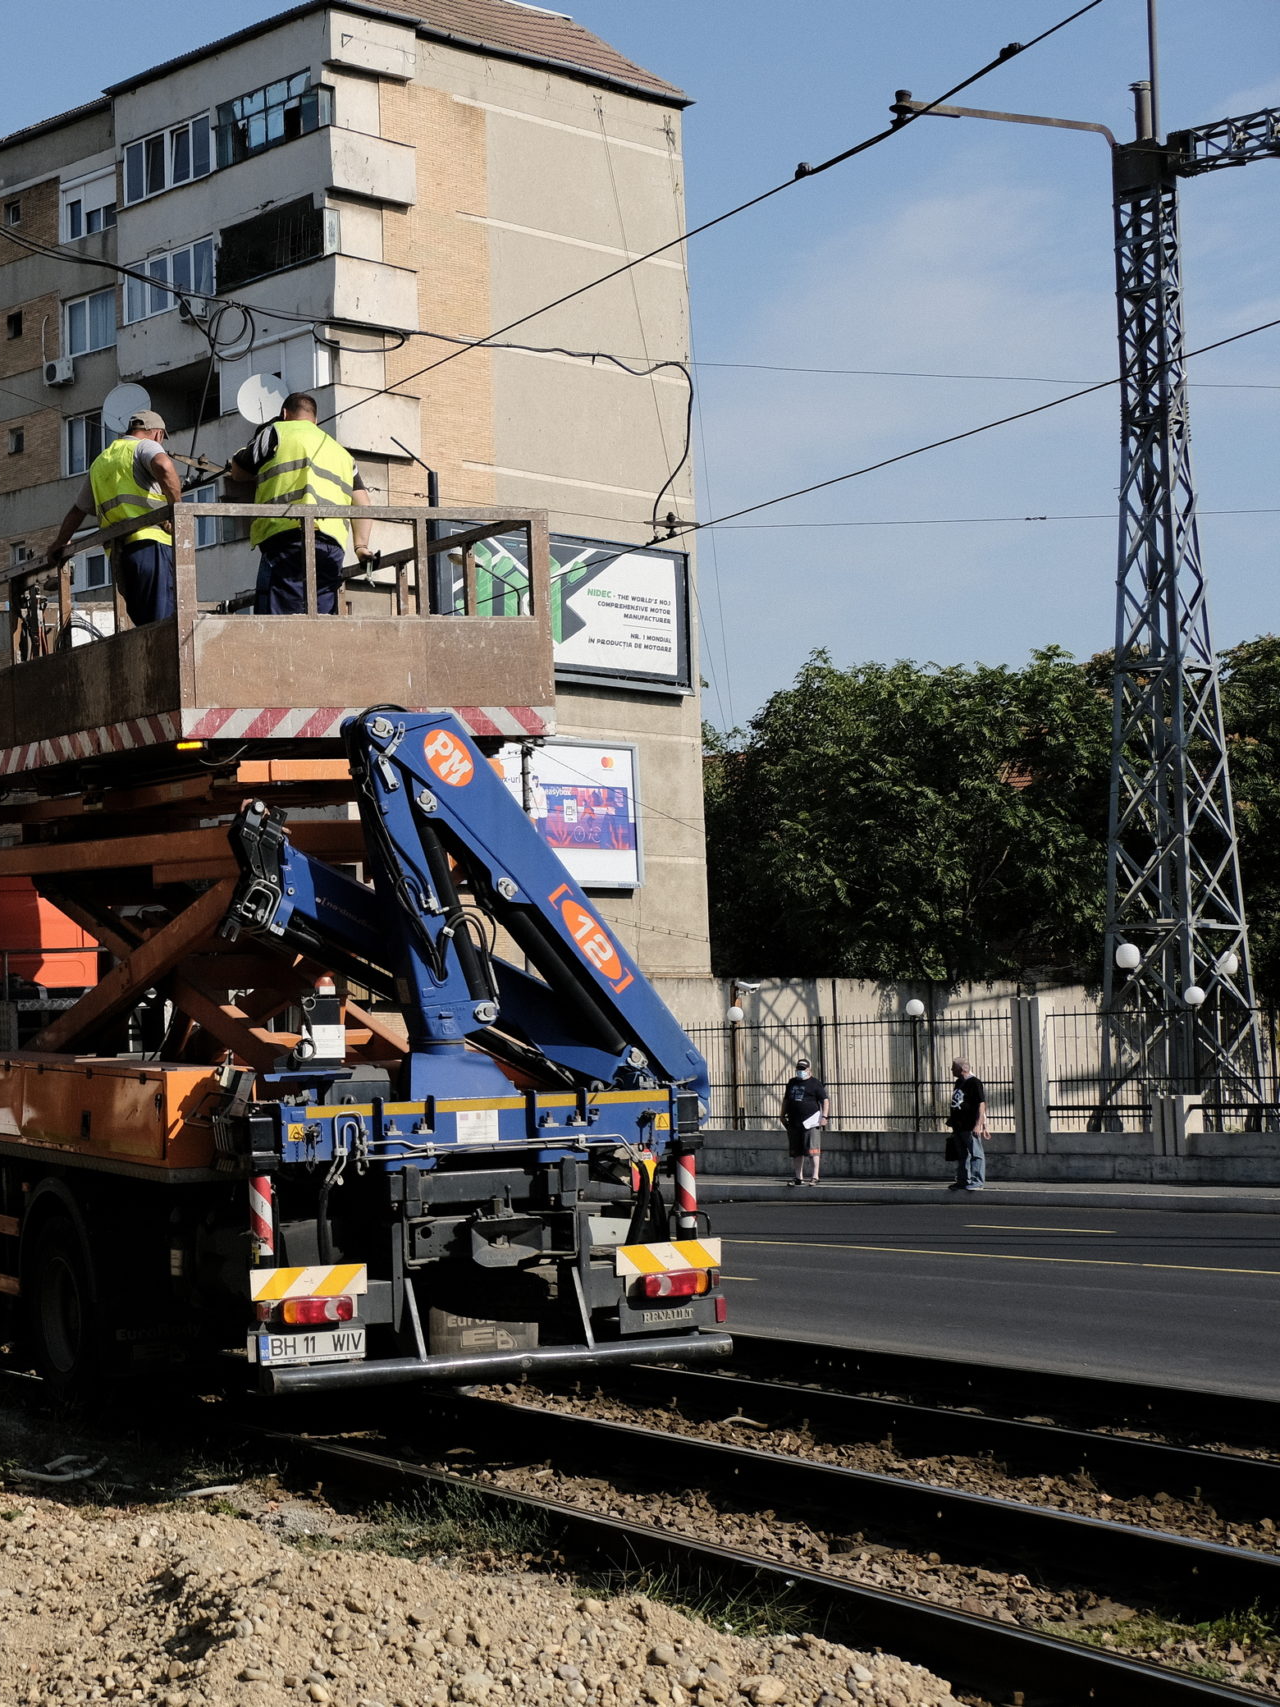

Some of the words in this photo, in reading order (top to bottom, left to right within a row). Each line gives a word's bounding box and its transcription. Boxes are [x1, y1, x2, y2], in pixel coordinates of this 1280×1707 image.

[587, 588, 611, 598] NIDEC
[631, 595, 657, 604] WORLD'S
[597, 600, 648, 612] COMPREHENSIVE
[650, 607, 671, 615] MOTOR
[623, 613, 671, 624] MANUFACTURER
[646, 635, 671, 643] MONDIAL
[643, 645, 672, 653] MOTOARE
[424, 731, 473, 785] PM
[574, 914, 614, 969] 12
[643, 1308, 693, 1324] RENAULT
[271, 1336, 297, 1357] BH
[303, 1335, 316, 1354] 11
[331, 1332, 362, 1353] WIV
